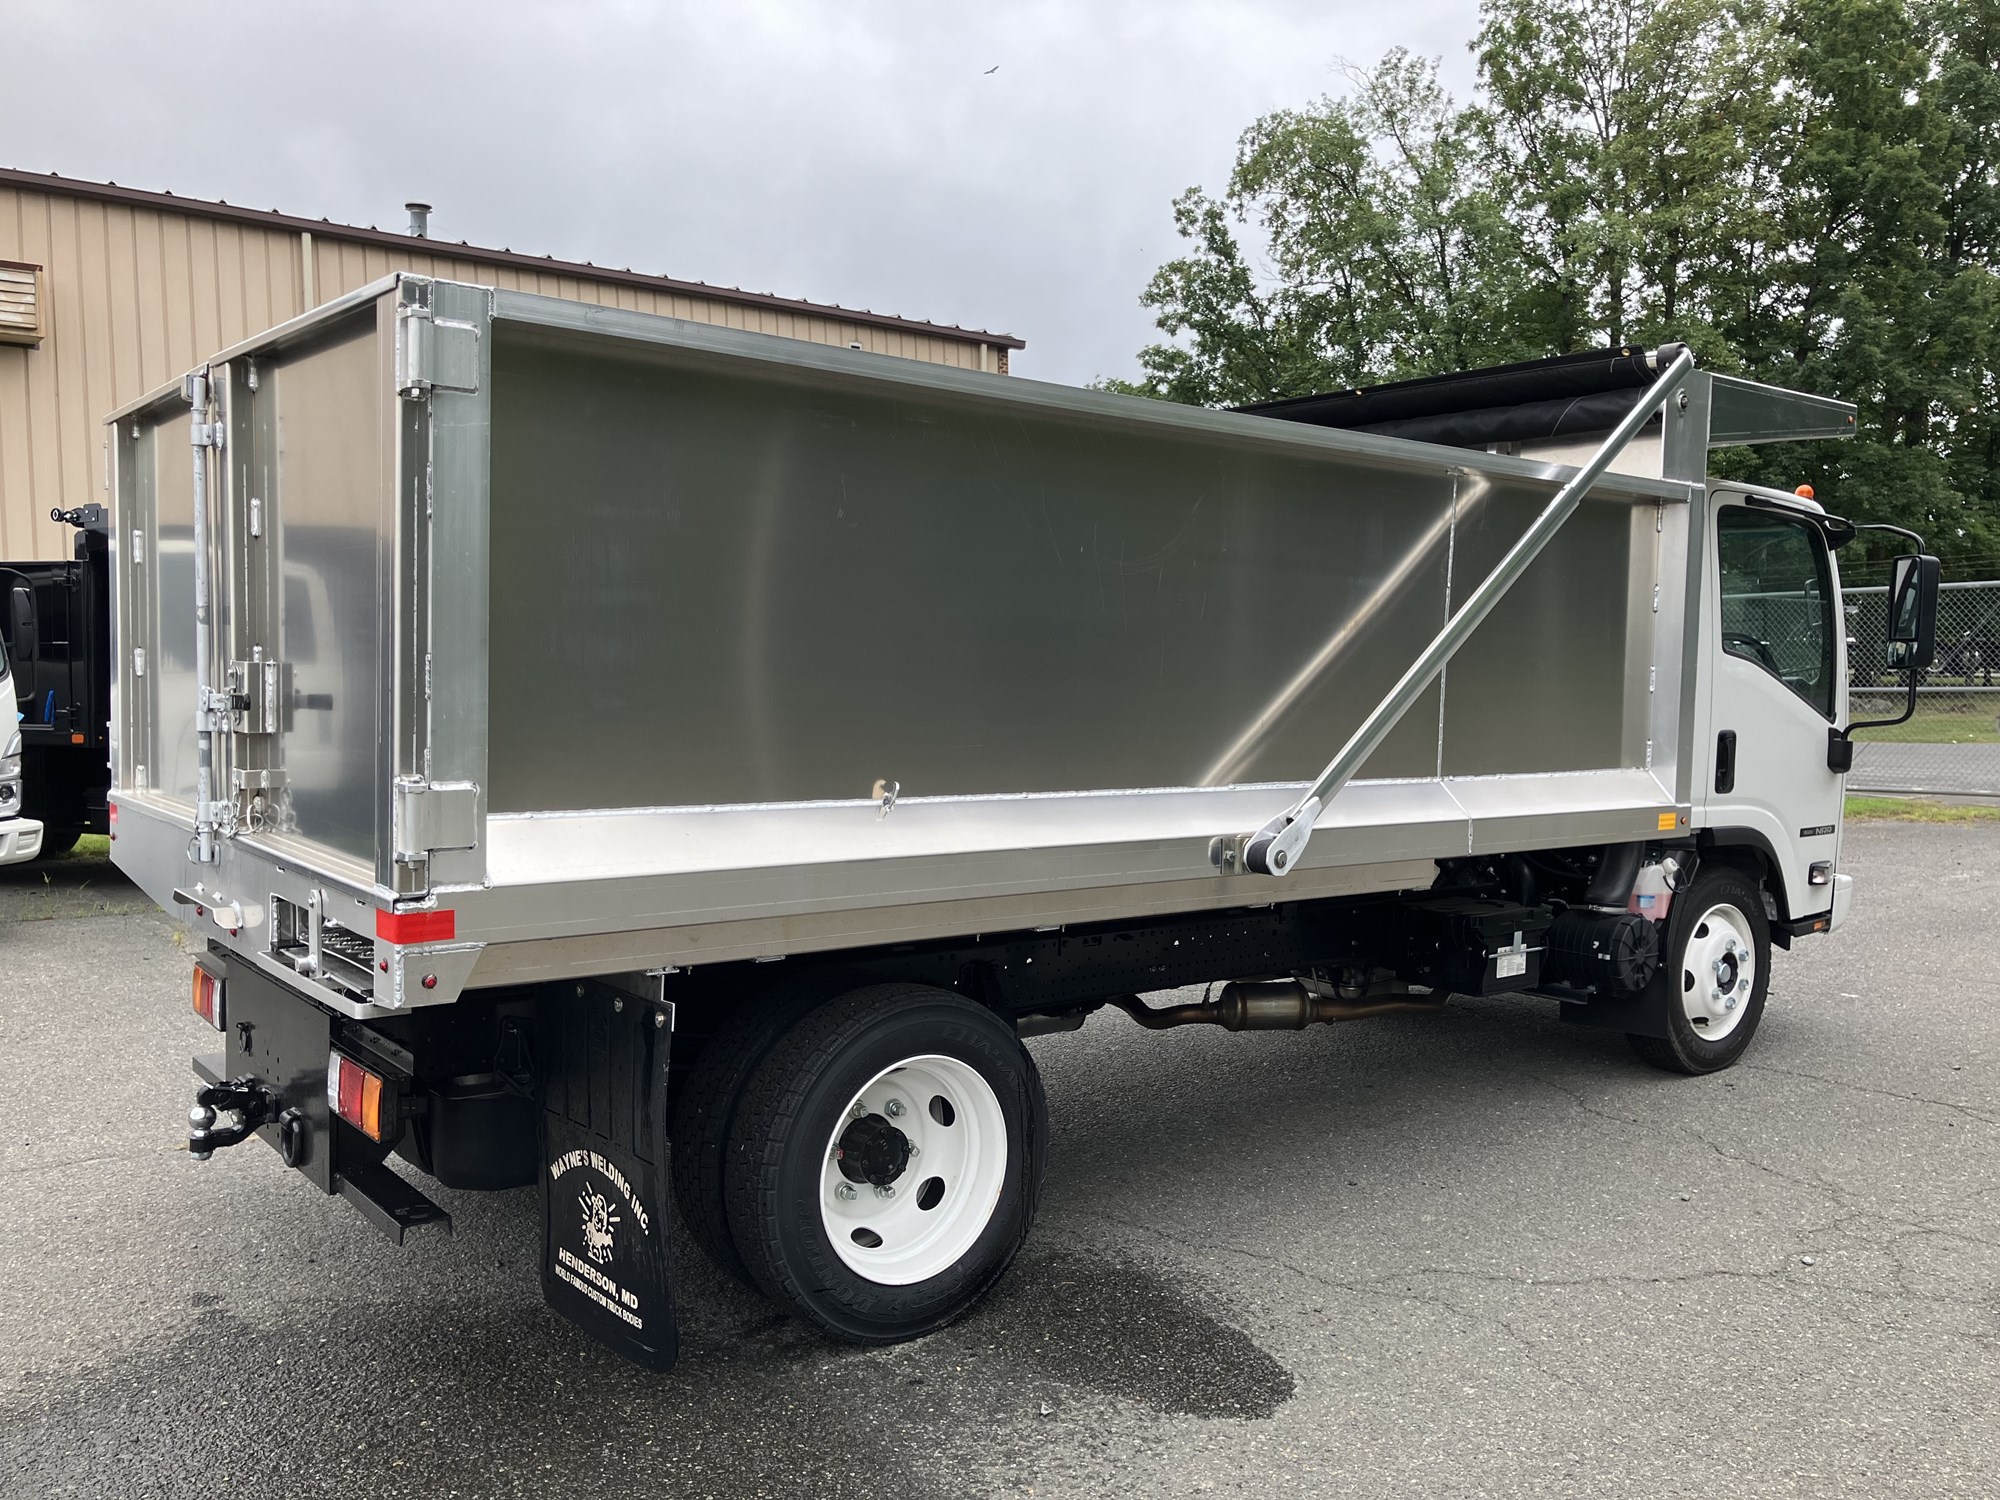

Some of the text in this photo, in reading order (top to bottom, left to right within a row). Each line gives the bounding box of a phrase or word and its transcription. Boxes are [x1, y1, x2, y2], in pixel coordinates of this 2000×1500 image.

[550, 1149, 649, 1236] WAYNE'S WELDING INC.
[554, 1263, 643, 1330] WORLD FAMOUS CUSTOM TRUCK BODIES
[558, 1246, 639, 1310] HENDERSON, MD
